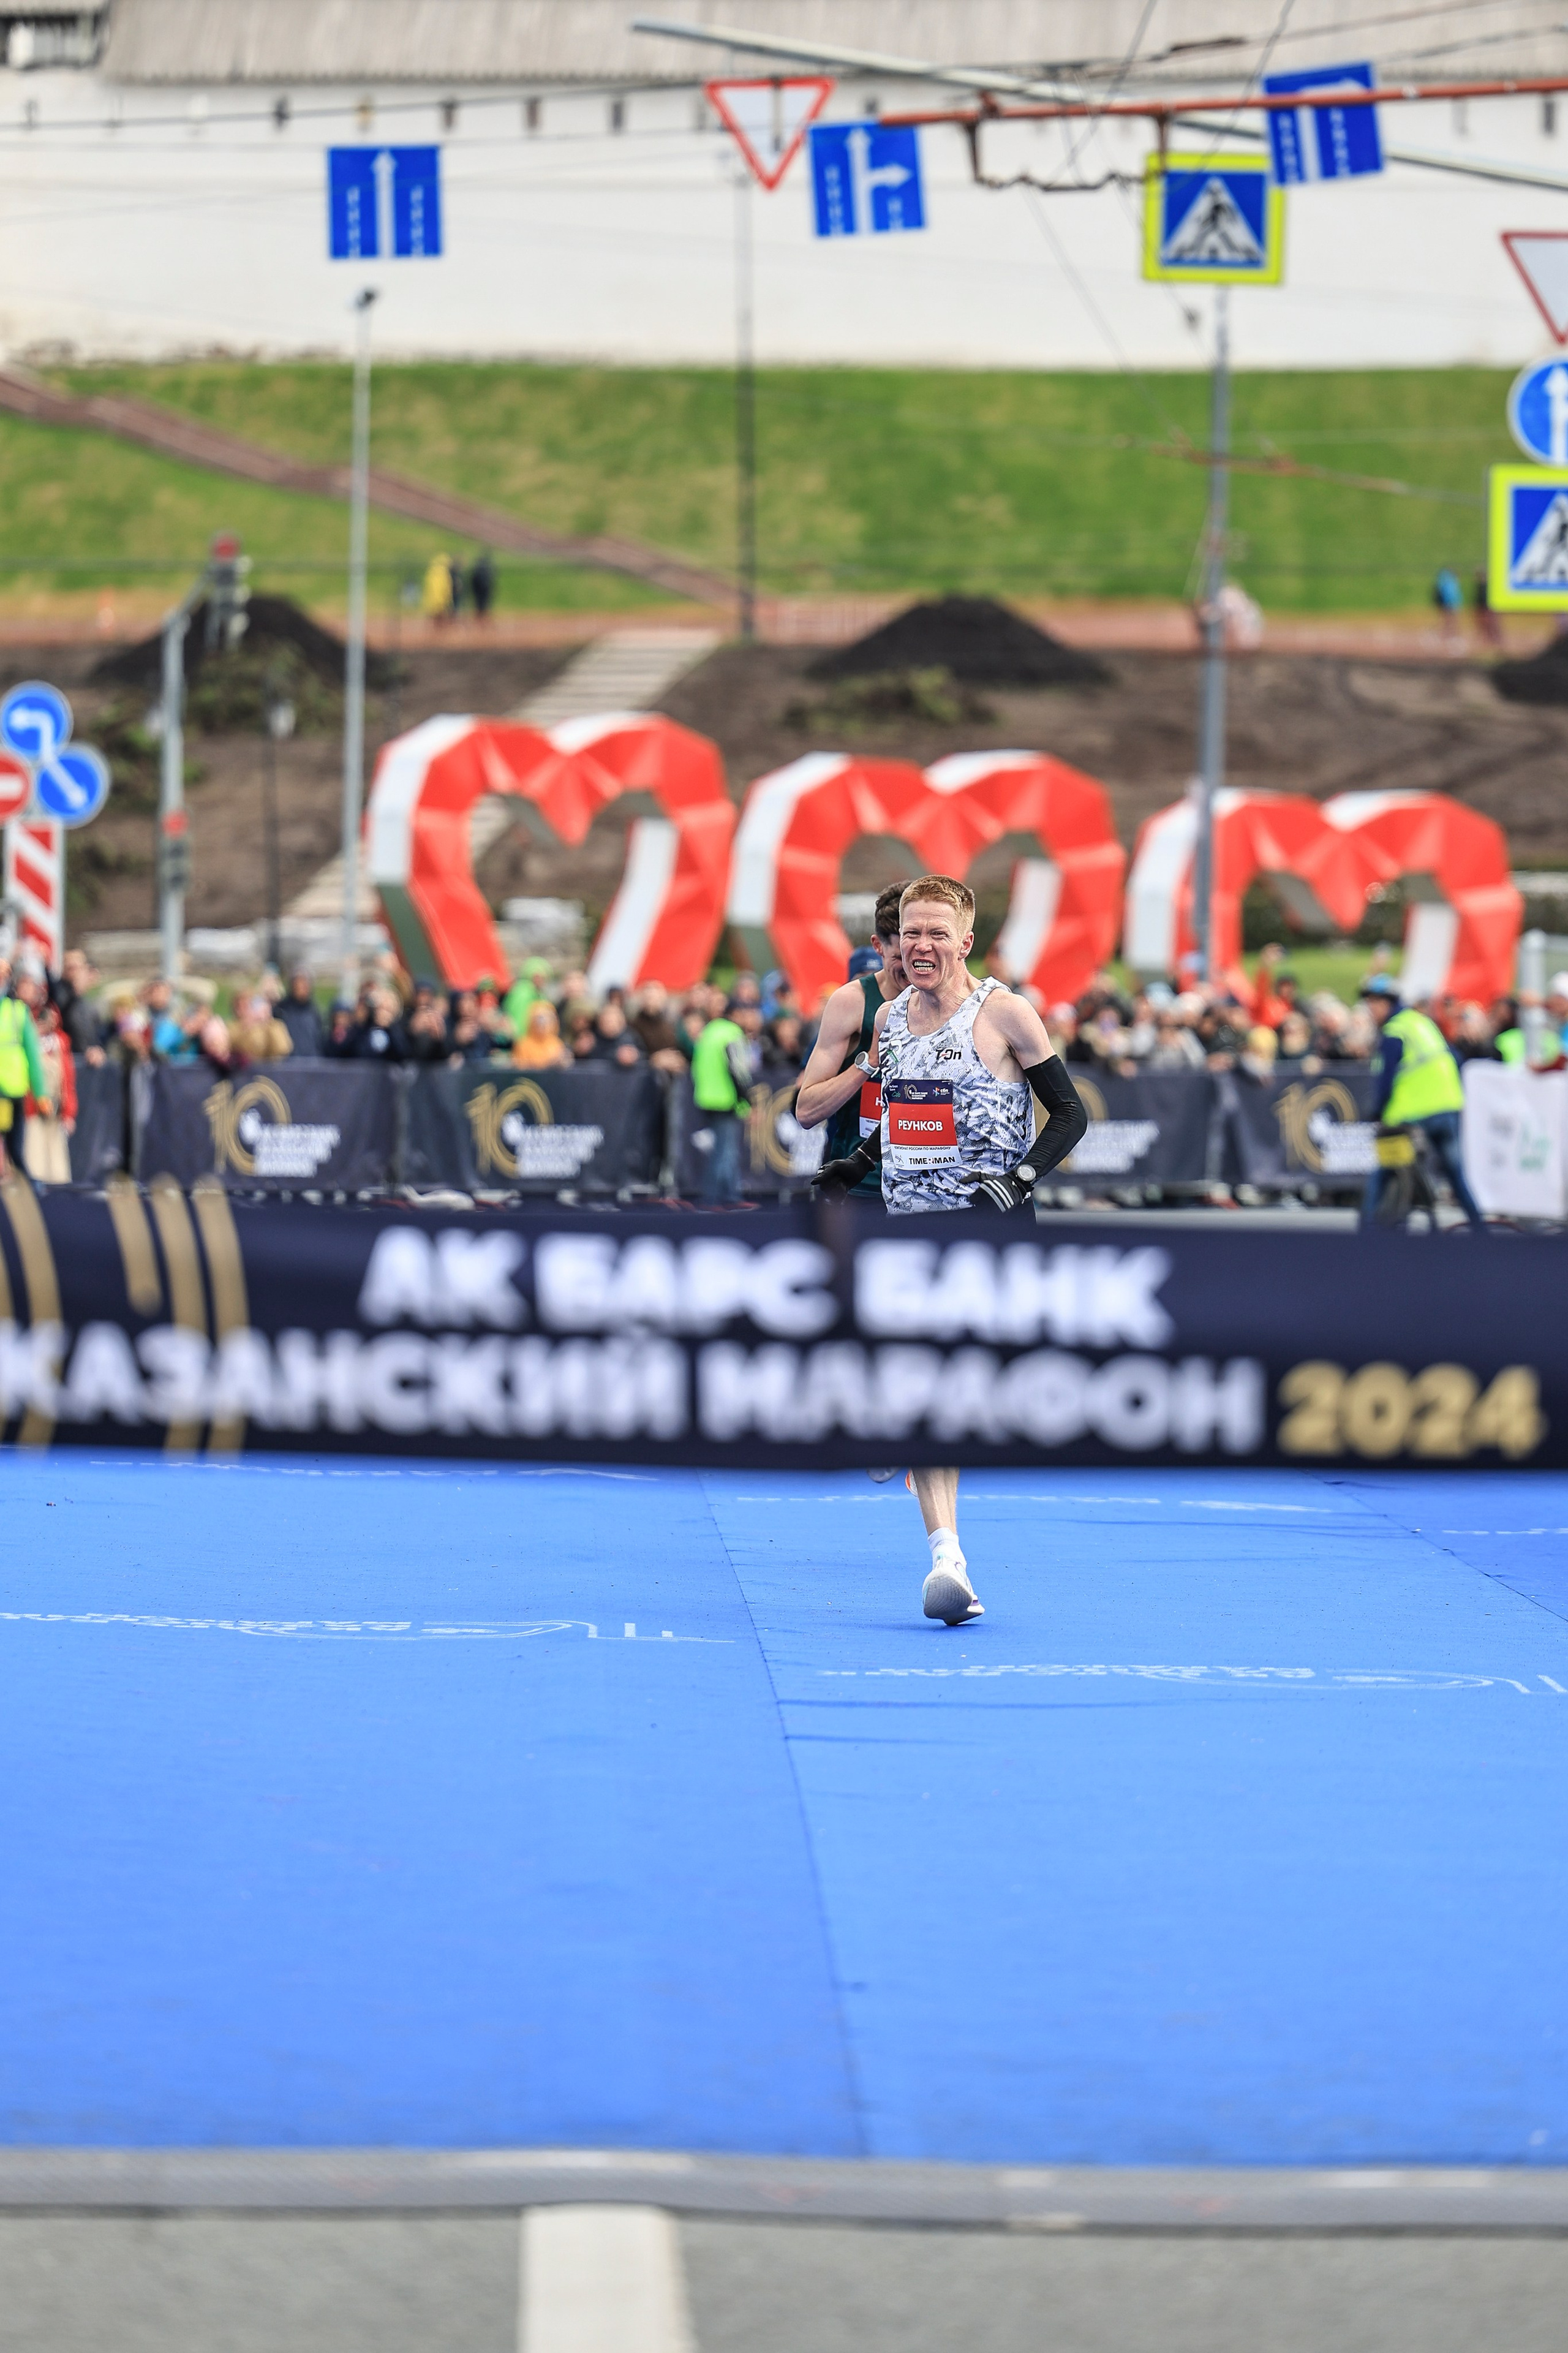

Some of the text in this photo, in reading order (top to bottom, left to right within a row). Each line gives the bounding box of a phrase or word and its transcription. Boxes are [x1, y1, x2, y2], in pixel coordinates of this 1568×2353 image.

[898, 1120, 943, 1131] РЕУНКОВ
[359, 1226, 1173, 1348] АК БАРС БАНК
[0, 1318, 1545, 1459] КАЗАНСКИЙ МАРАФОН 2024
